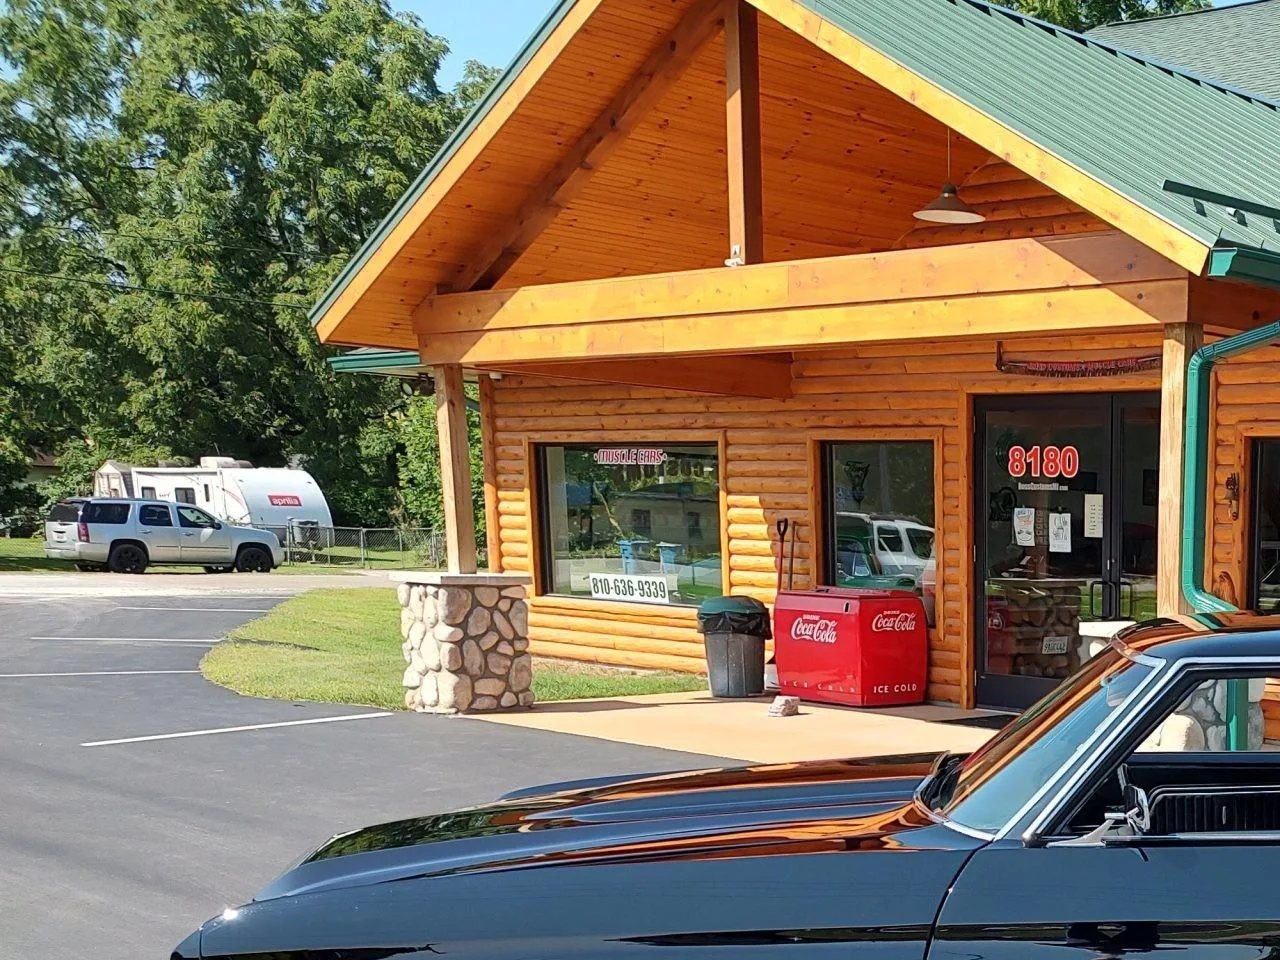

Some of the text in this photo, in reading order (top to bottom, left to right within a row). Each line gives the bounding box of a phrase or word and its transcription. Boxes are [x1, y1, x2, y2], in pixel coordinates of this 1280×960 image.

[597, 448, 663, 465] MUSCLE CARS
[1008, 445, 1079, 478] 8180
[592, 577, 666, 599] 810-636-9339
[791, 617, 838, 644] Coca-Cola
[872, 612, 917, 632] Coca-Cola
[873, 683, 917, 694] ICE COLD
